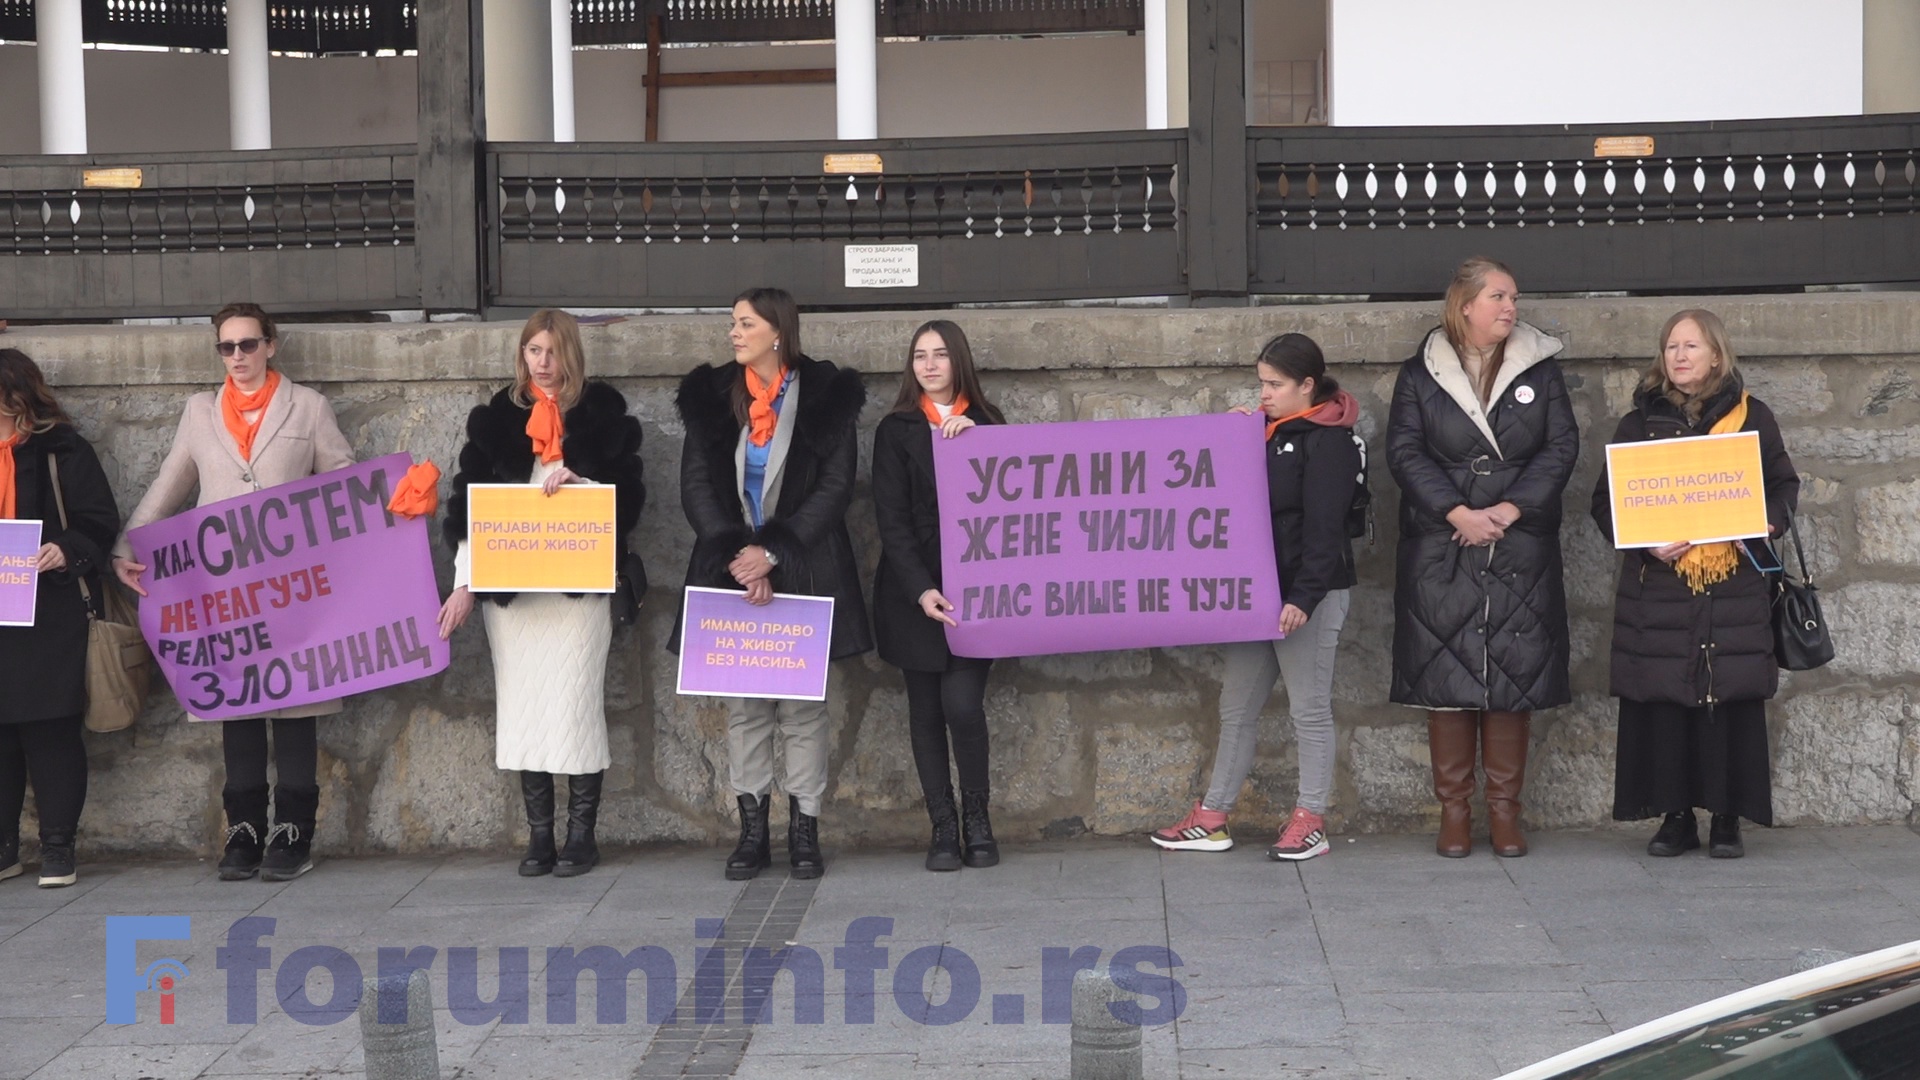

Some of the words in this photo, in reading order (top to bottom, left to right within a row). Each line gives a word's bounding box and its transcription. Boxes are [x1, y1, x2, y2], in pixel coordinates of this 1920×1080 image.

[966, 451, 1146, 504] УСТАНИ
[1164, 448, 1216, 489] ЗА
[1628, 477, 1670, 491] СТОП
[1675, 470, 1745, 487] НАСИЉУ
[1624, 494, 1679, 508] ПРЕМА
[1682, 487, 1752, 503] ЖЕНАМА
[153, 539, 195, 581] КАД
[197, 468, 395, 576] СИСТЕМ
[473, 522, 541, 533] ПРИЈАВИ
[547, 522, 612, 533] НАСИЉЕ
[958, 511, 1061, 563] ЖЕНЕ
[1079, 508, 1176, 551] ЧИЈИ
[1187, 507, 1230, 549] СЕ
[487, 539, 539, 550] СПАСИ
[544, 539, 598, 550] ЖИВОТ
[0, 555, 37, 568] АЊЕ
[160, 599, 198, 634] НЕ
[202, 563, 332, 627] РЕАГУЈЕ
[961, 583, 1031, 621] ГЛАС
[1045, 579, 1126, 617] ВИШЕ
[1137, 578, 1169, 613] НЕ
[1181, 577, 1253, 611] ЧУЈЕ
[700, 618, 757, 633] ИМАМО
[762, 622, 814, 637] ПРАВО
[158, 621, 272, 667] РЕАГУЈЕ
[715, 637, 736, 649] НА
[740, 638, 796, 652] ЖИВОТ
[188, 616, 432, 711] ЗЛОЧИНАЦ
[706, 653, 734, 666] БЕЗ
[739, 656, 806, 669] НАСИЉА
